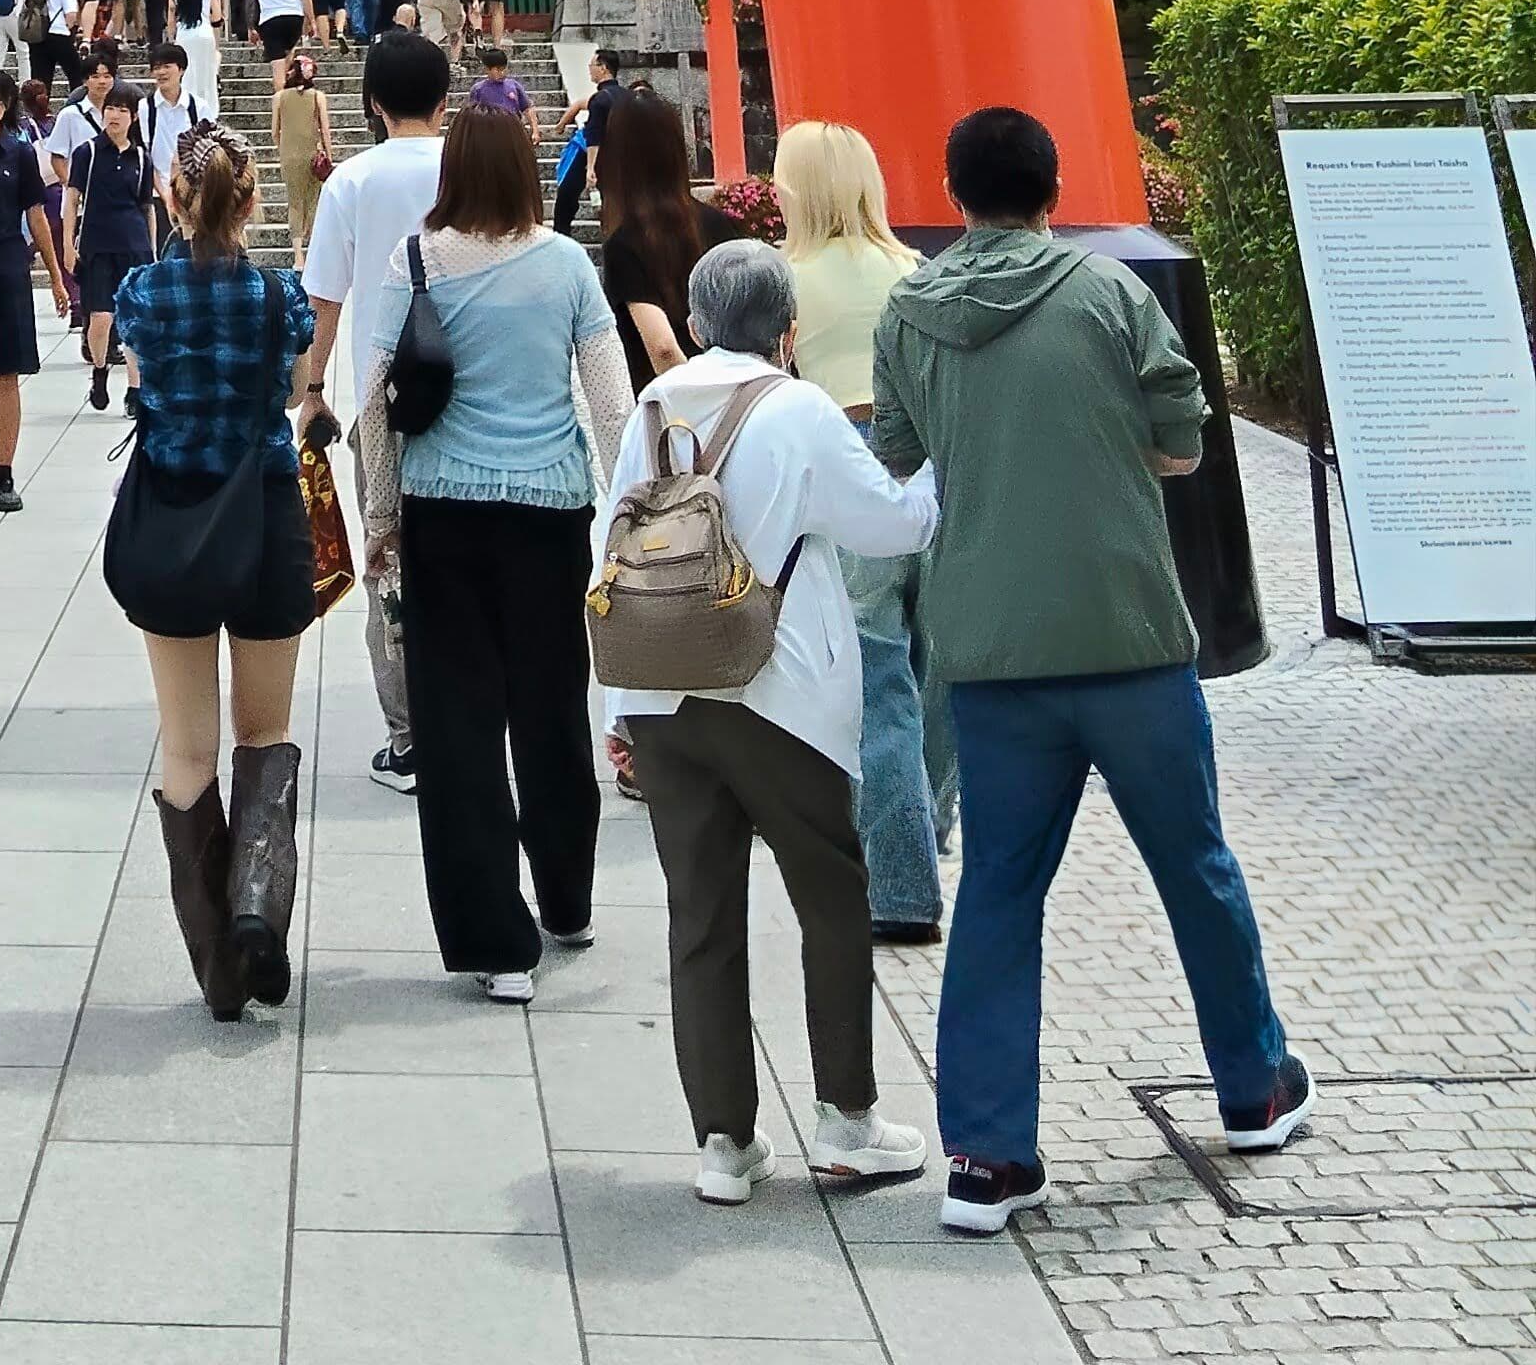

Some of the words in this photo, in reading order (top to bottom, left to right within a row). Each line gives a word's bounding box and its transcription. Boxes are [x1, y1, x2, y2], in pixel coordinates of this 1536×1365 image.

[1306, 161, 1348, 171] Requests
[1351, 160, 1374, 169] from
[1376, 159, 1412, 169] Fushimi
[1414, 159, 1436, 168] Inari
[1438, 158, 1469, 168] Taisha
